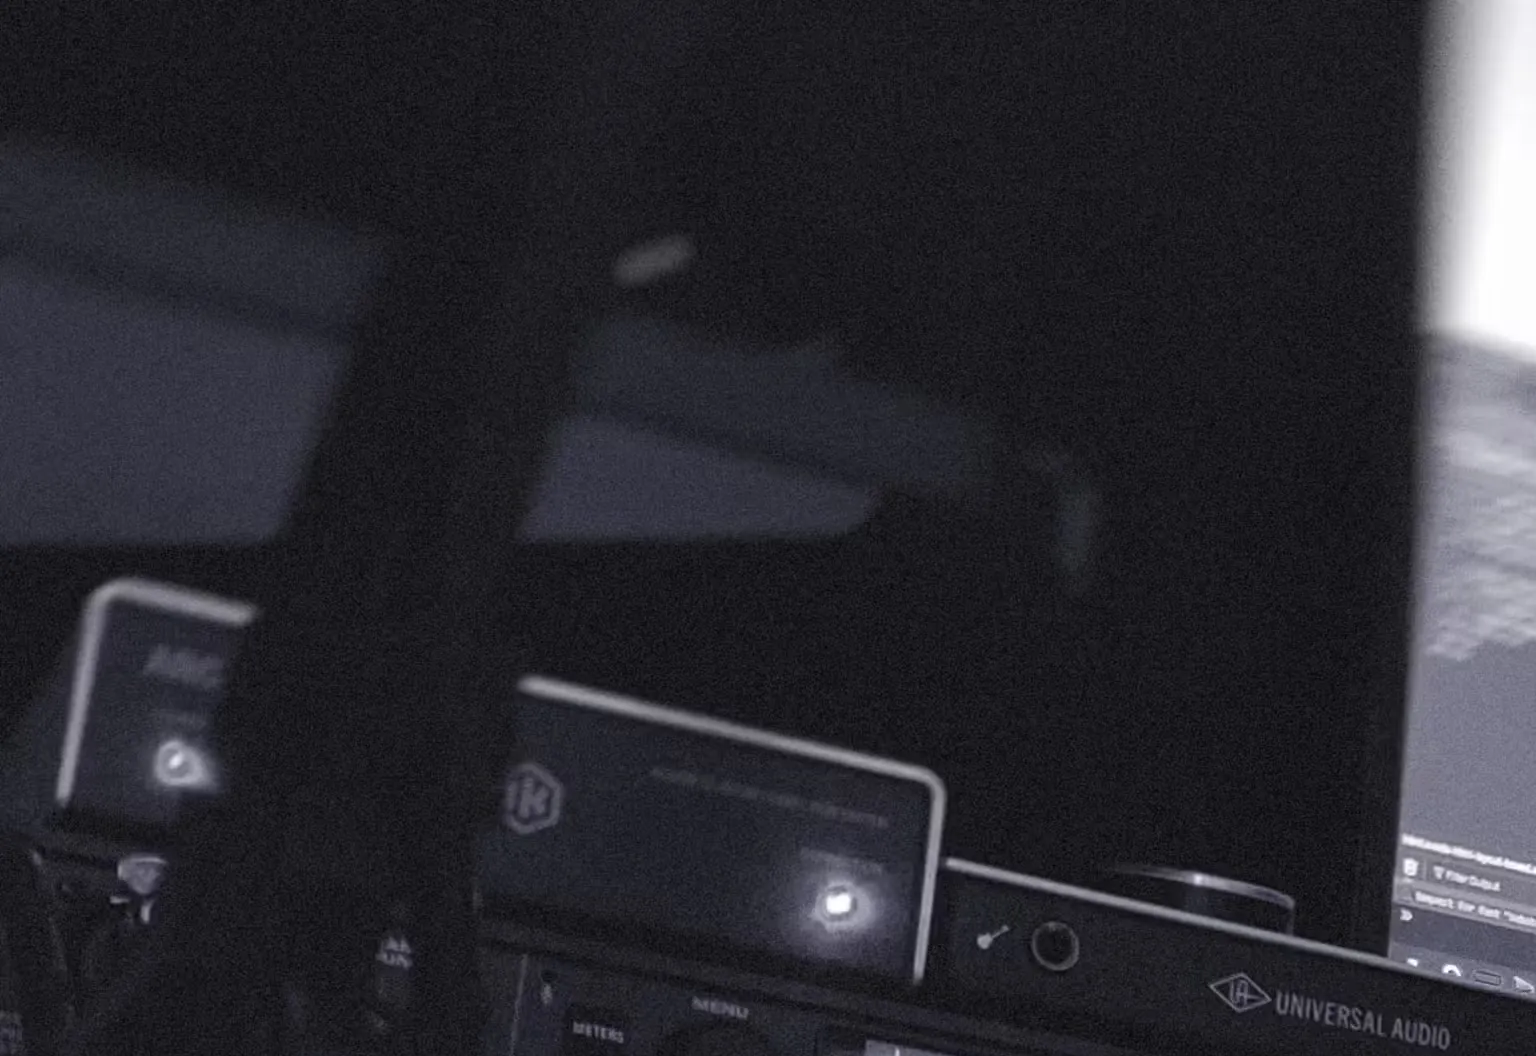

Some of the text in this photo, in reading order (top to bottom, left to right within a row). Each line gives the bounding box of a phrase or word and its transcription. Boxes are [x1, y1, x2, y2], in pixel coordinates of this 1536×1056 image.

[692, 996, 749, 1020] MENU
[1275, 989, 1386, 1037] UNIVERSAL
[1391, 1018, 1450, 1050] AUDIO
[572, 1020, 624, 1044] METERS
